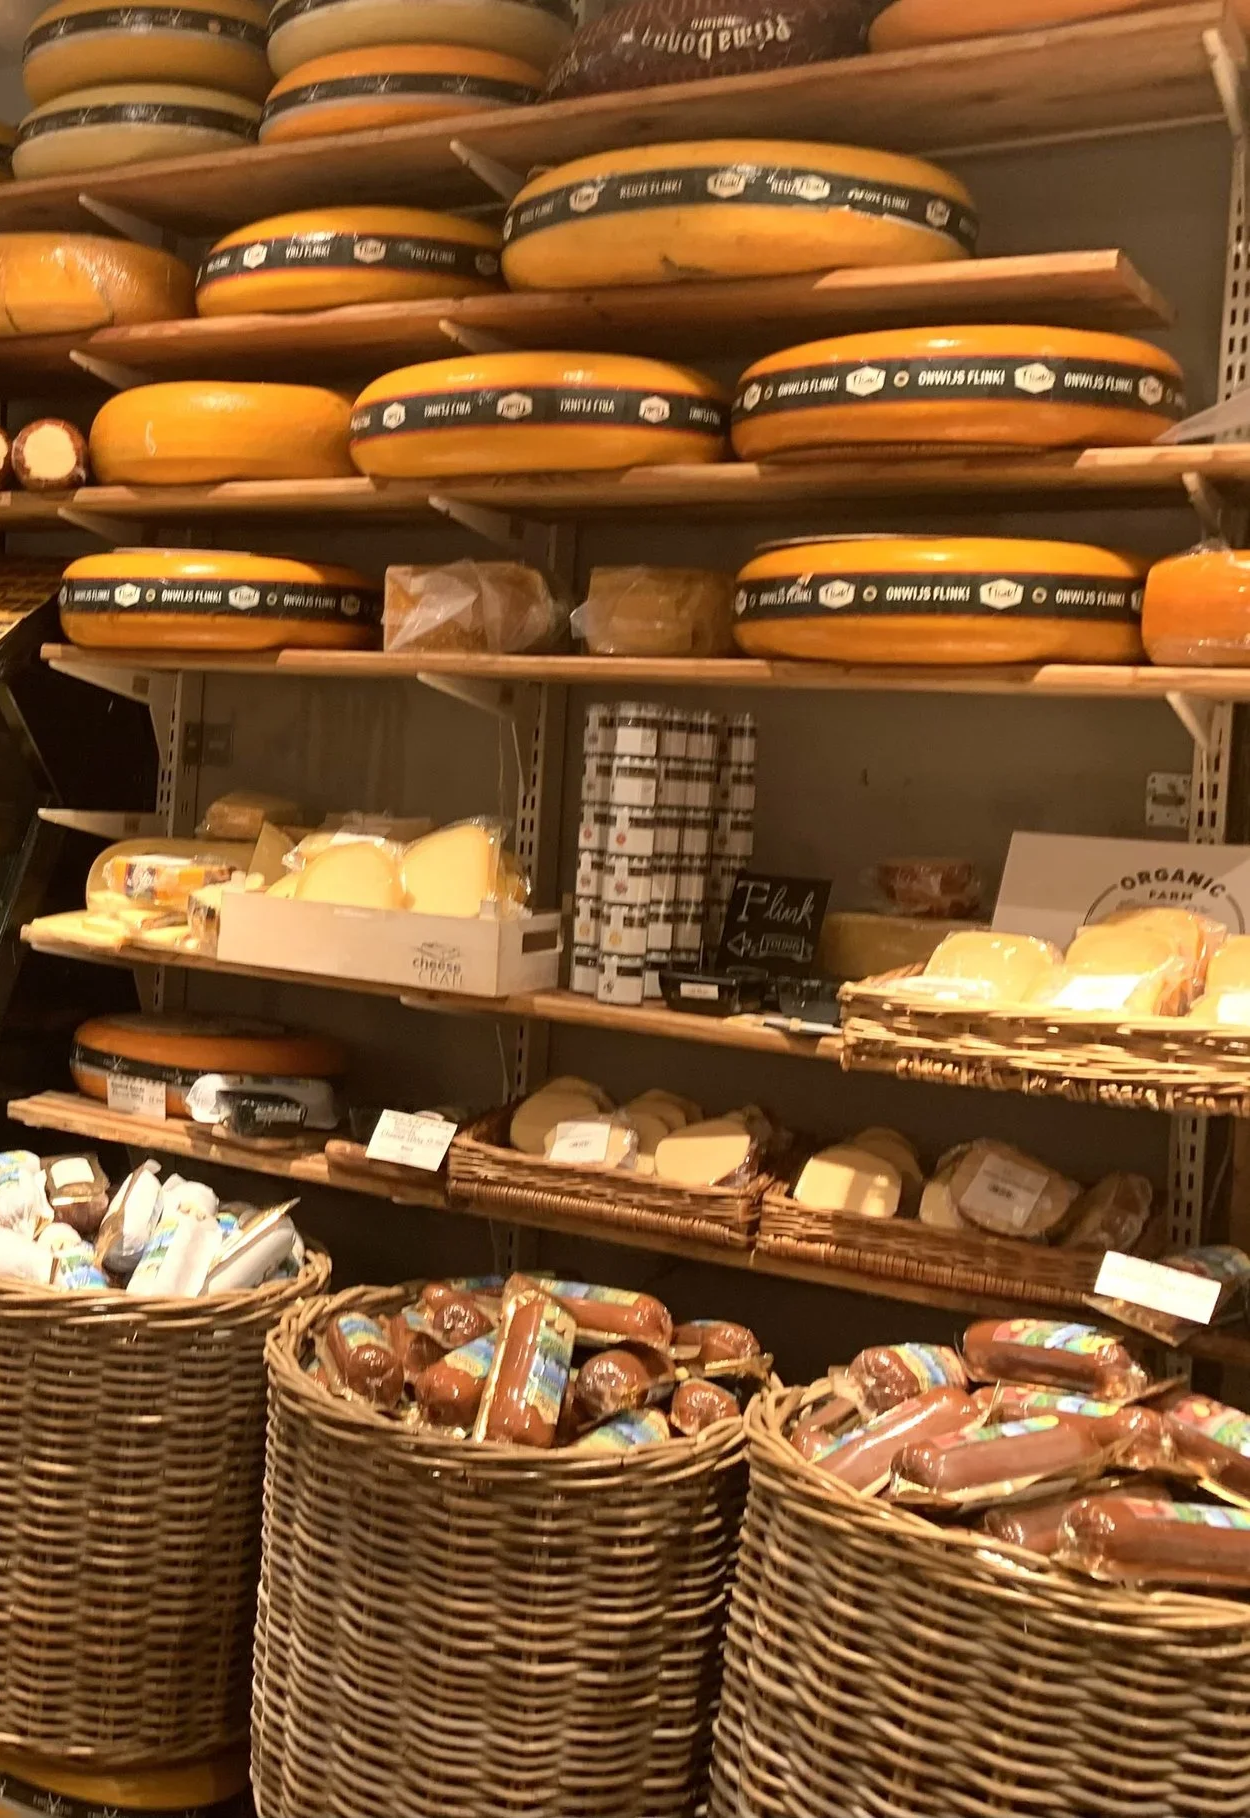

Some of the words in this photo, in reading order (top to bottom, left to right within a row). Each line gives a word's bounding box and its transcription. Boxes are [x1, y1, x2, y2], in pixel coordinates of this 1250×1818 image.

[917, 369, 967, 387] ONWIJS
[966, 368, 1006, 386] FLINK!
[1065, 371, 1105, 390] ONWIJS
[161, 590, 195, 604] ONWIJS
[885, 585, 932, 602] ONWIJS
[932, 585, 971, 602] FLINK!
[1055, 588, 1097, 606] ONWIJS
[1120, 867, 1227, 899] ORGANIC
[1149, 889, 1194, 902] FARM
[736, 880, 815, 931] Flink
[412, 955, 463, 973] cheese
